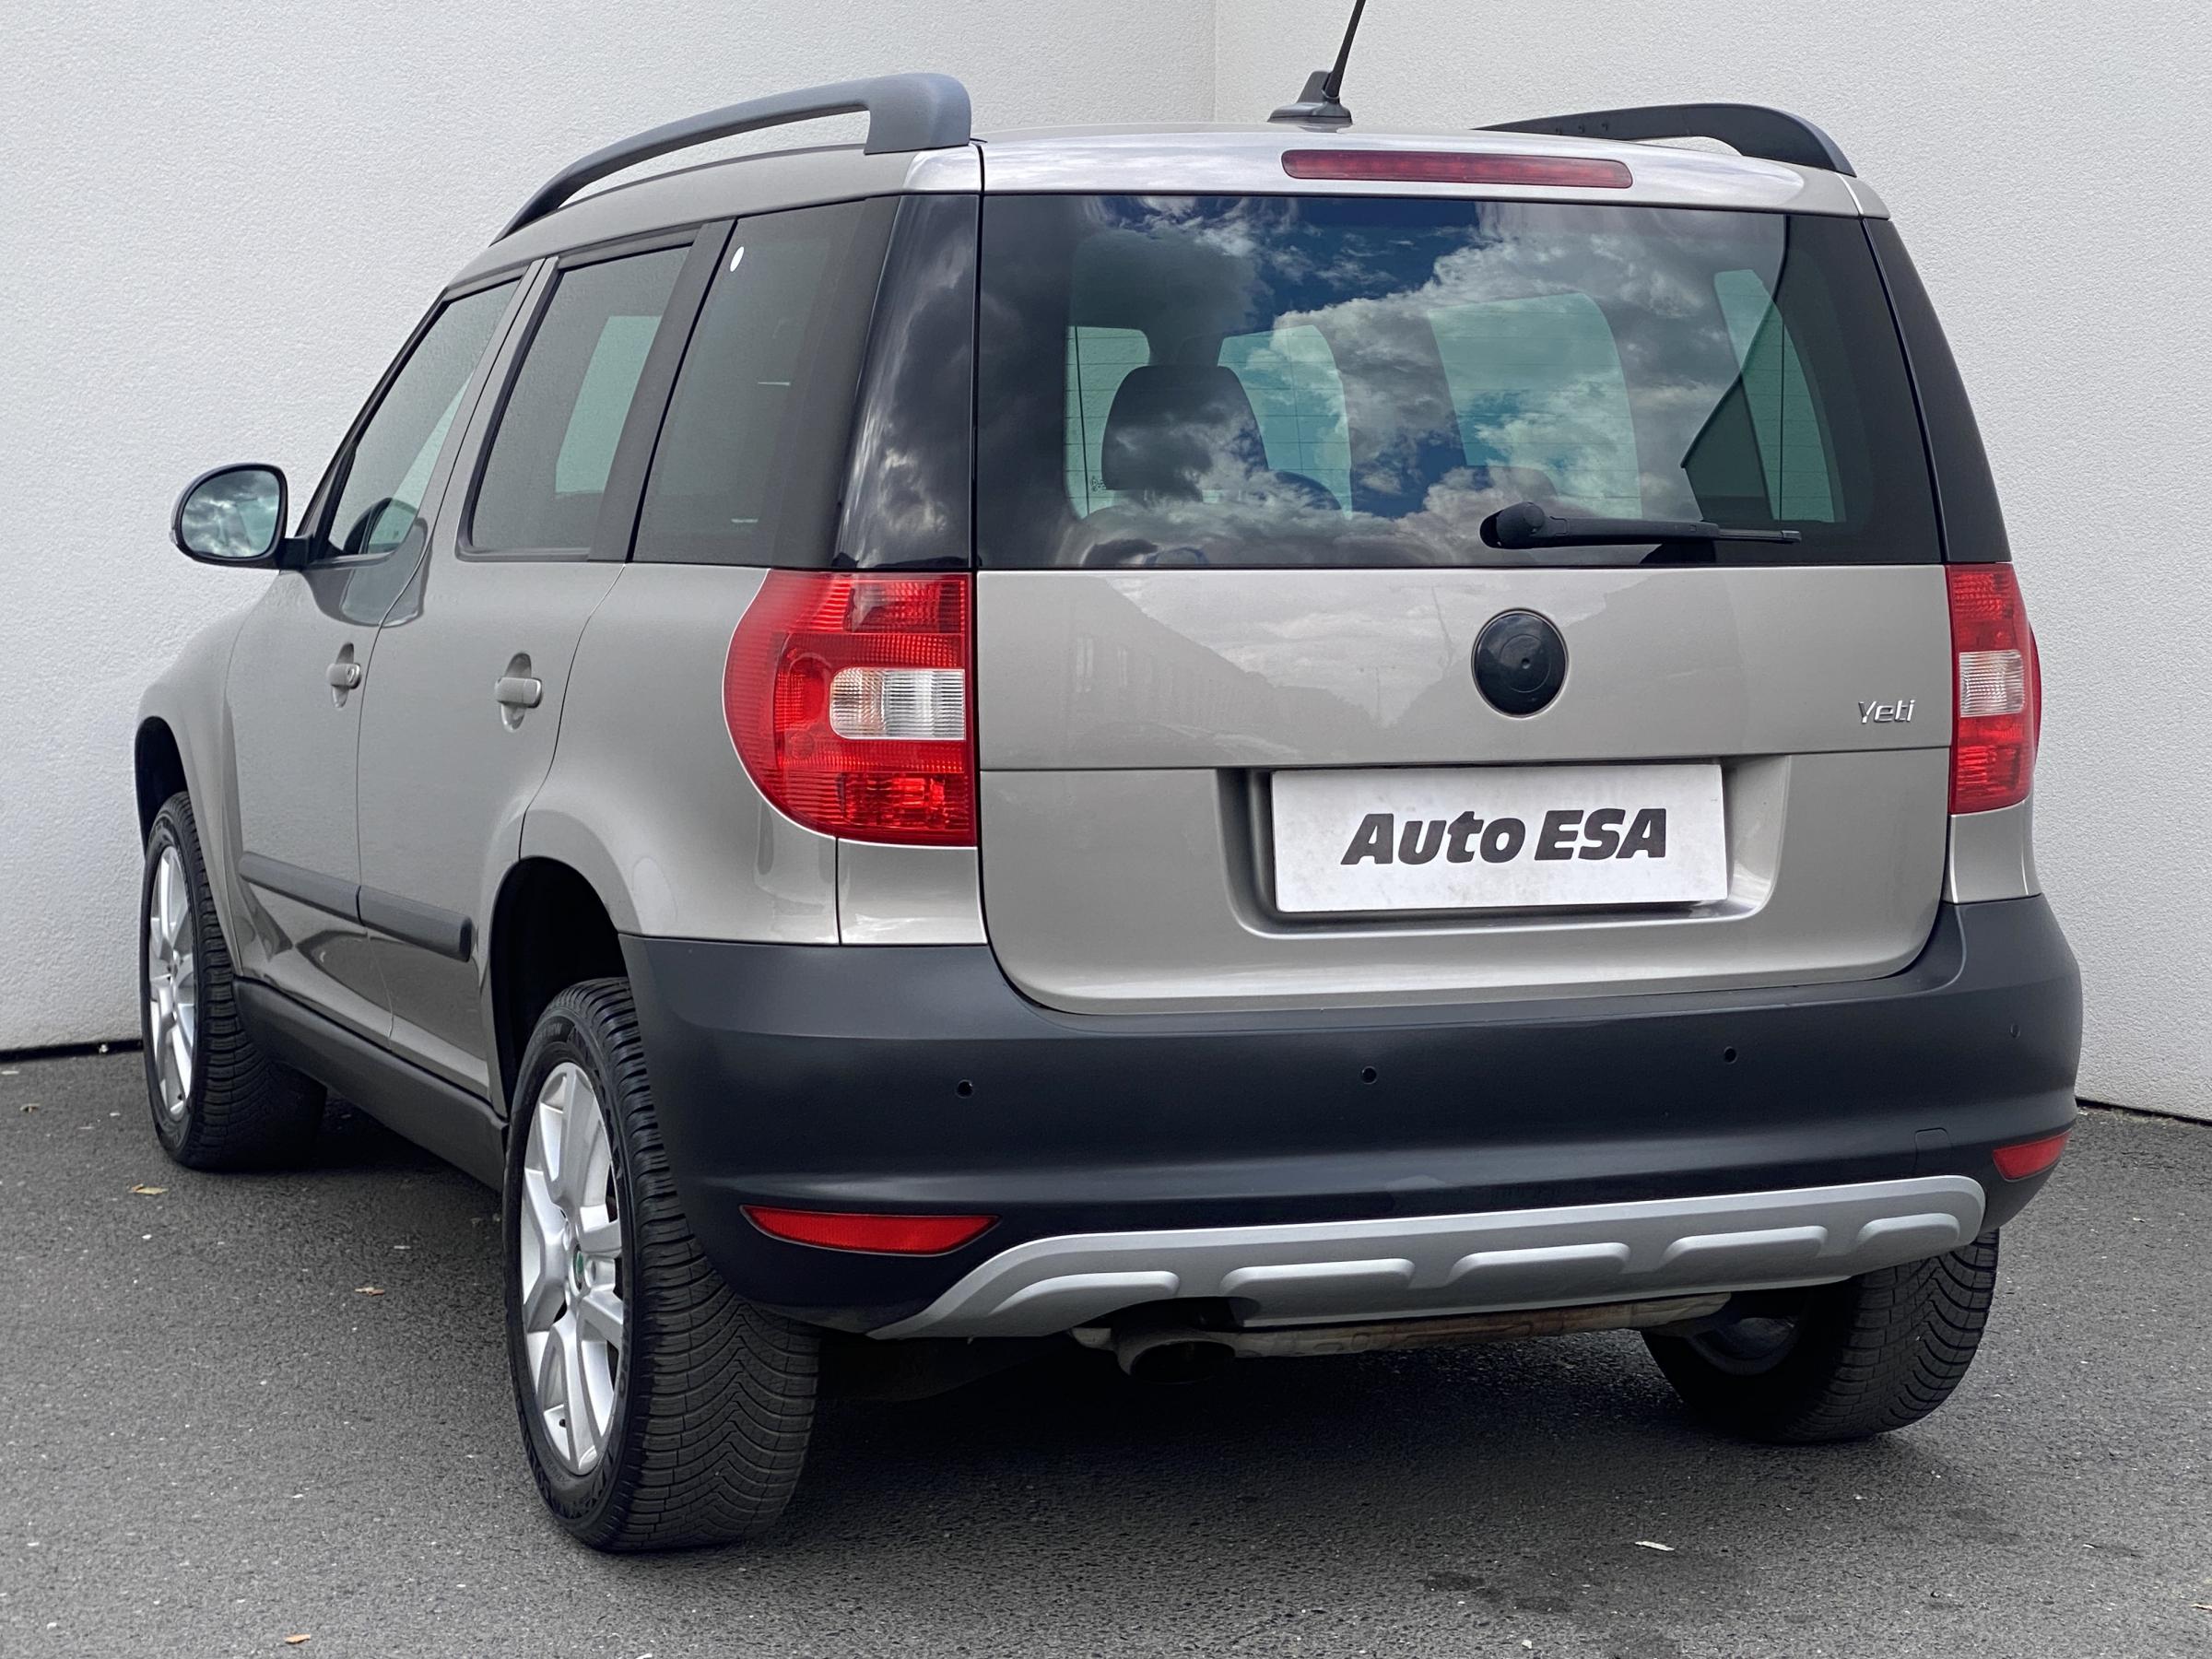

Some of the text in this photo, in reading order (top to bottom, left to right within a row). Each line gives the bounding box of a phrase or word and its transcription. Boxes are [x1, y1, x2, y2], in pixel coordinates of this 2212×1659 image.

[1858, 699, 1915, 724] Yeti
[1340, 807, 1667, 865] Auto ESA
